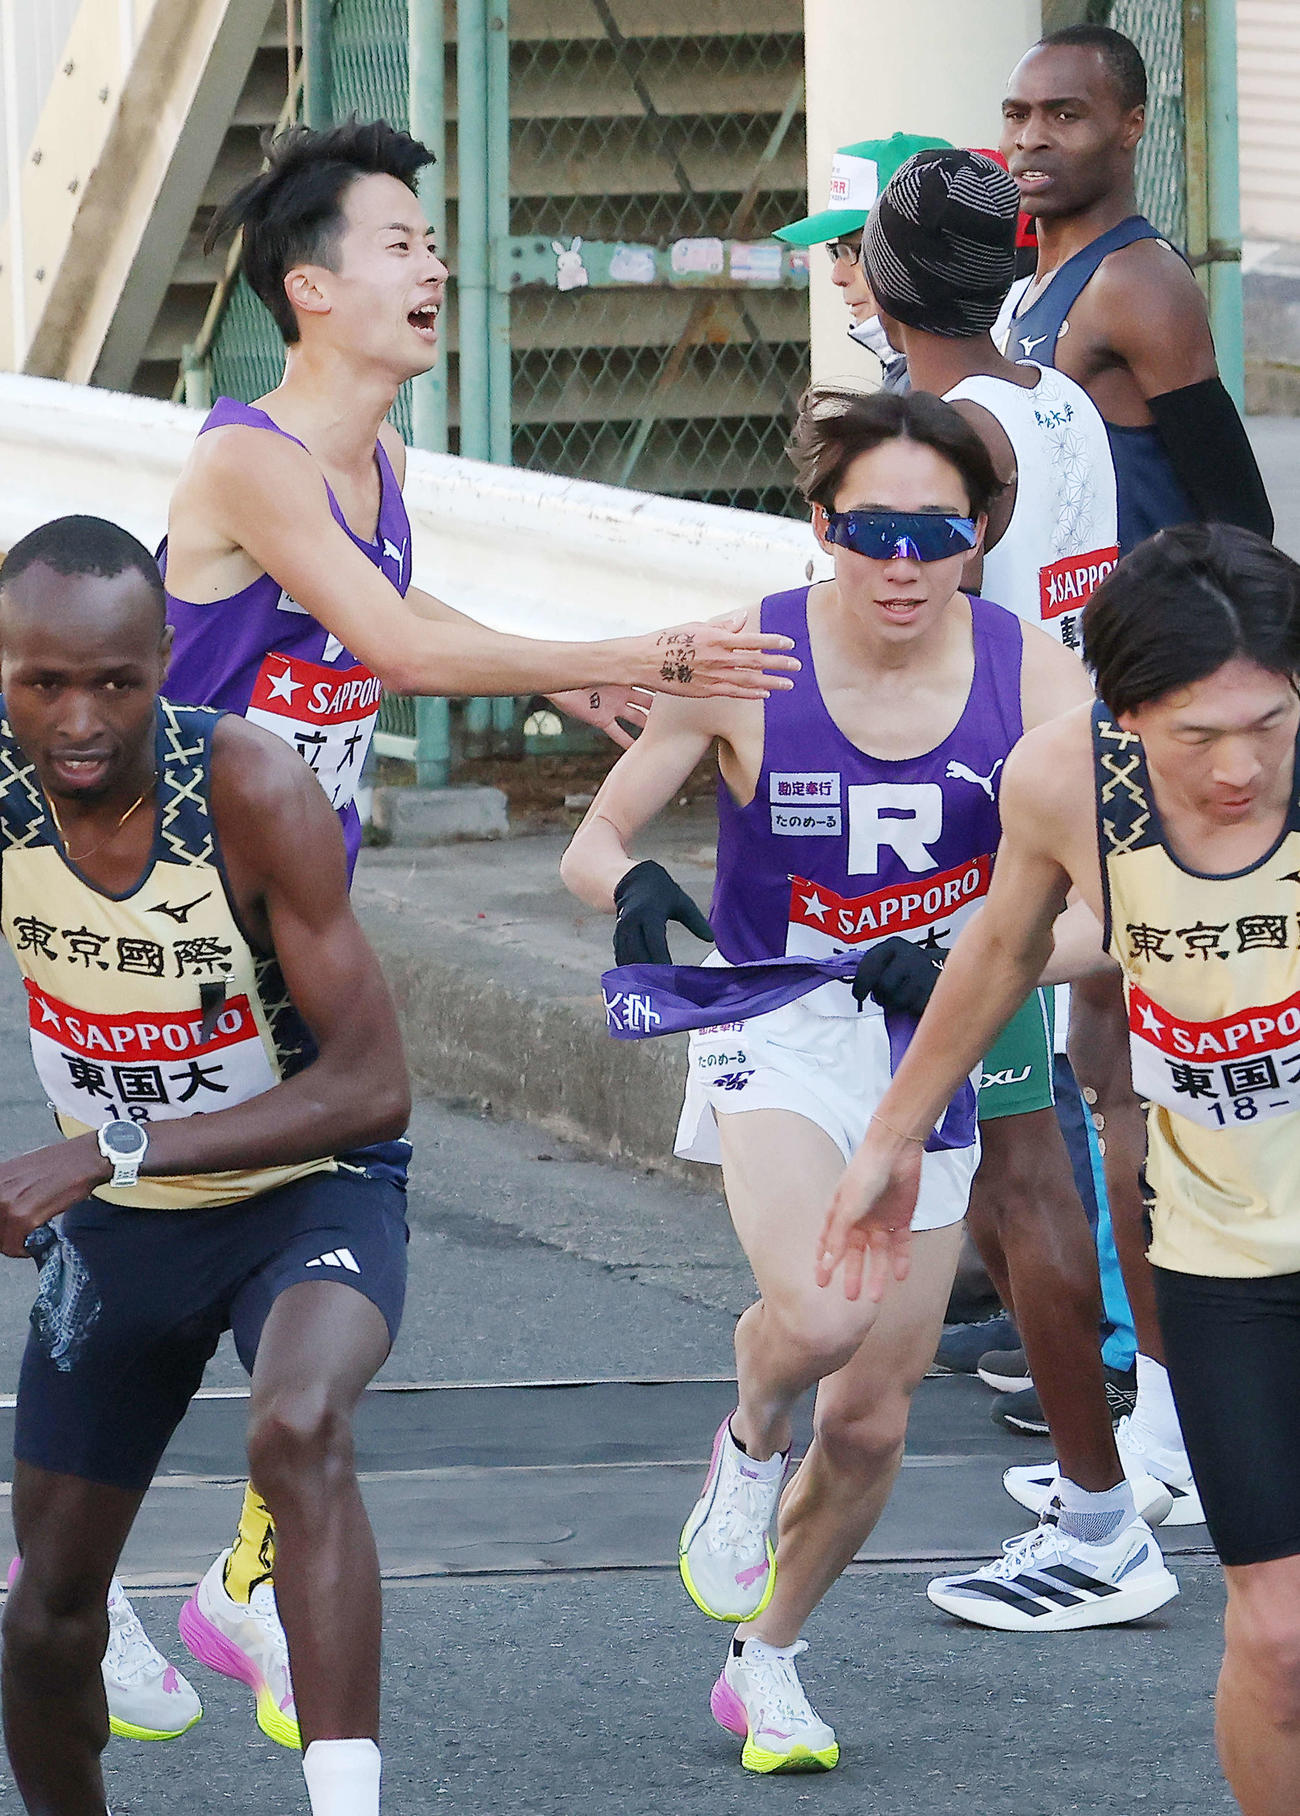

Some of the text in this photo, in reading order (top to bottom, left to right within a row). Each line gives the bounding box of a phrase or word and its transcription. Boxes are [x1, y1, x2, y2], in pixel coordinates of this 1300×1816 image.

[1056, 559, 1119, 603] SAPPO
[778, 780, 833, 796] 勘定奉行
[776, 814, 836, 828] たのめーる
[847, 783, 943, 876] R
[837, 867, 980, 936] SAPPORO
[13, 915, 233, 979] 東京國際
[1126, 911, 1300, 962] 東京國
[60, 1051, 230, 1104] 東国大
[698, 1050, 747, 1068] たのめーる
[977, 1065, 1033, 1090] XU
